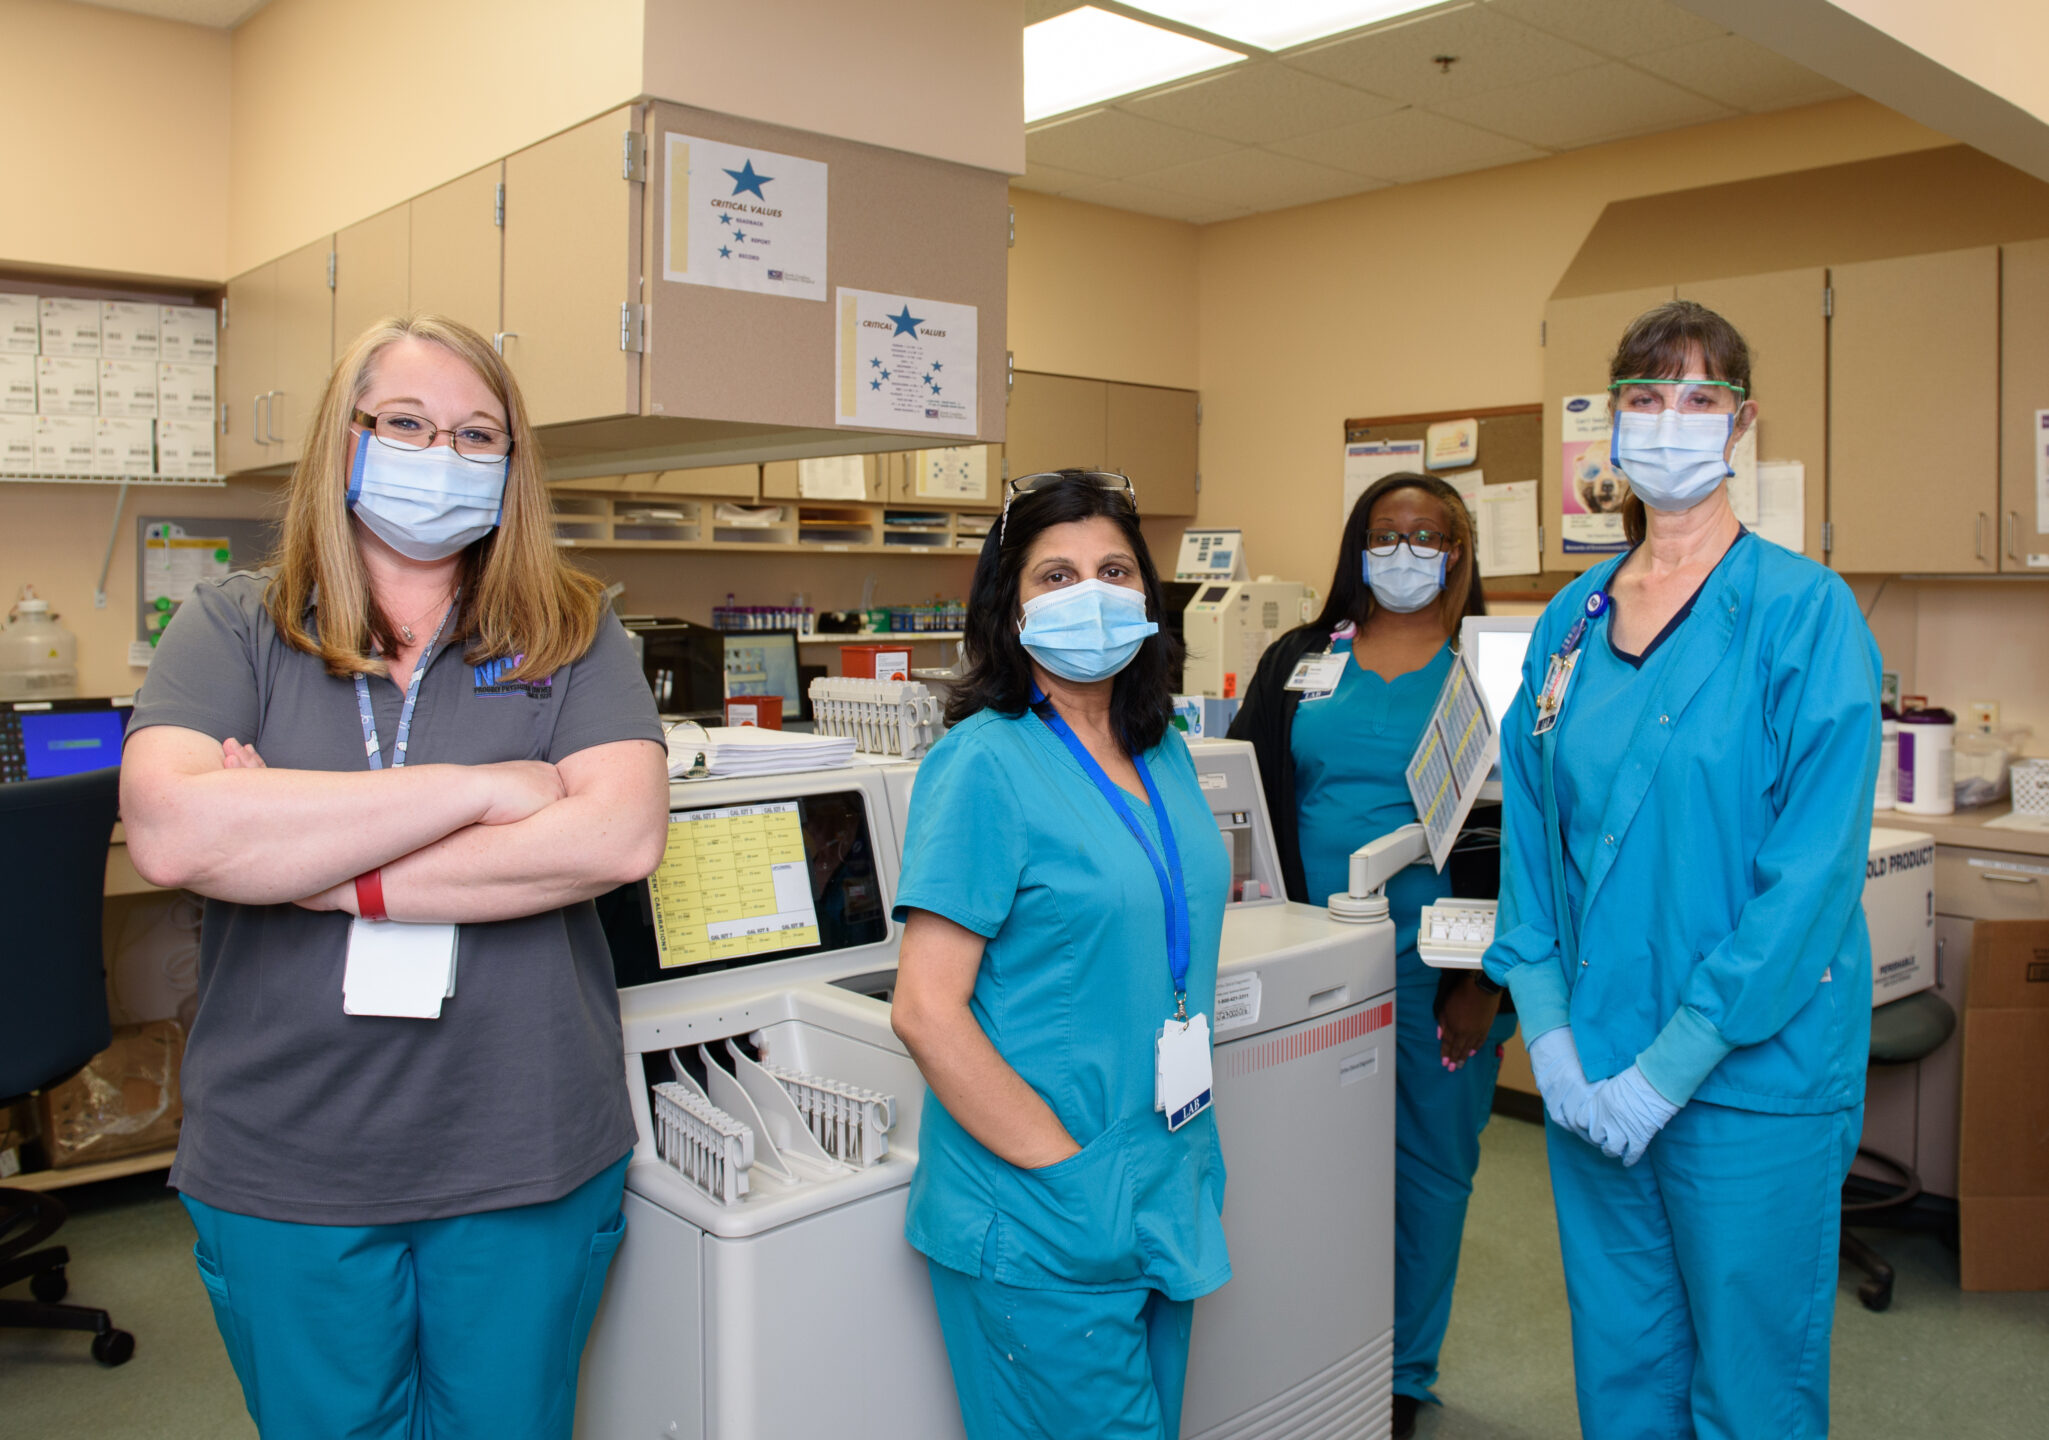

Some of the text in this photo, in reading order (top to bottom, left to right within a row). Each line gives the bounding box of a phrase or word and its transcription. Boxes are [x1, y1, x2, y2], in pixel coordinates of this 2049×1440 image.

[711, 199, 783, 218] CRITICAL VALUES
[862, 320, 947, 338] CRITICAL VALUES
[1866, 845, 1934, 879] OLD PRODUCT
[651, 873, 668, 952] CENT CALIBRATIONS
[1880, 955, 1916, 975] PERISHABLE
[1182, 1097, 1200, 1119] LAB
